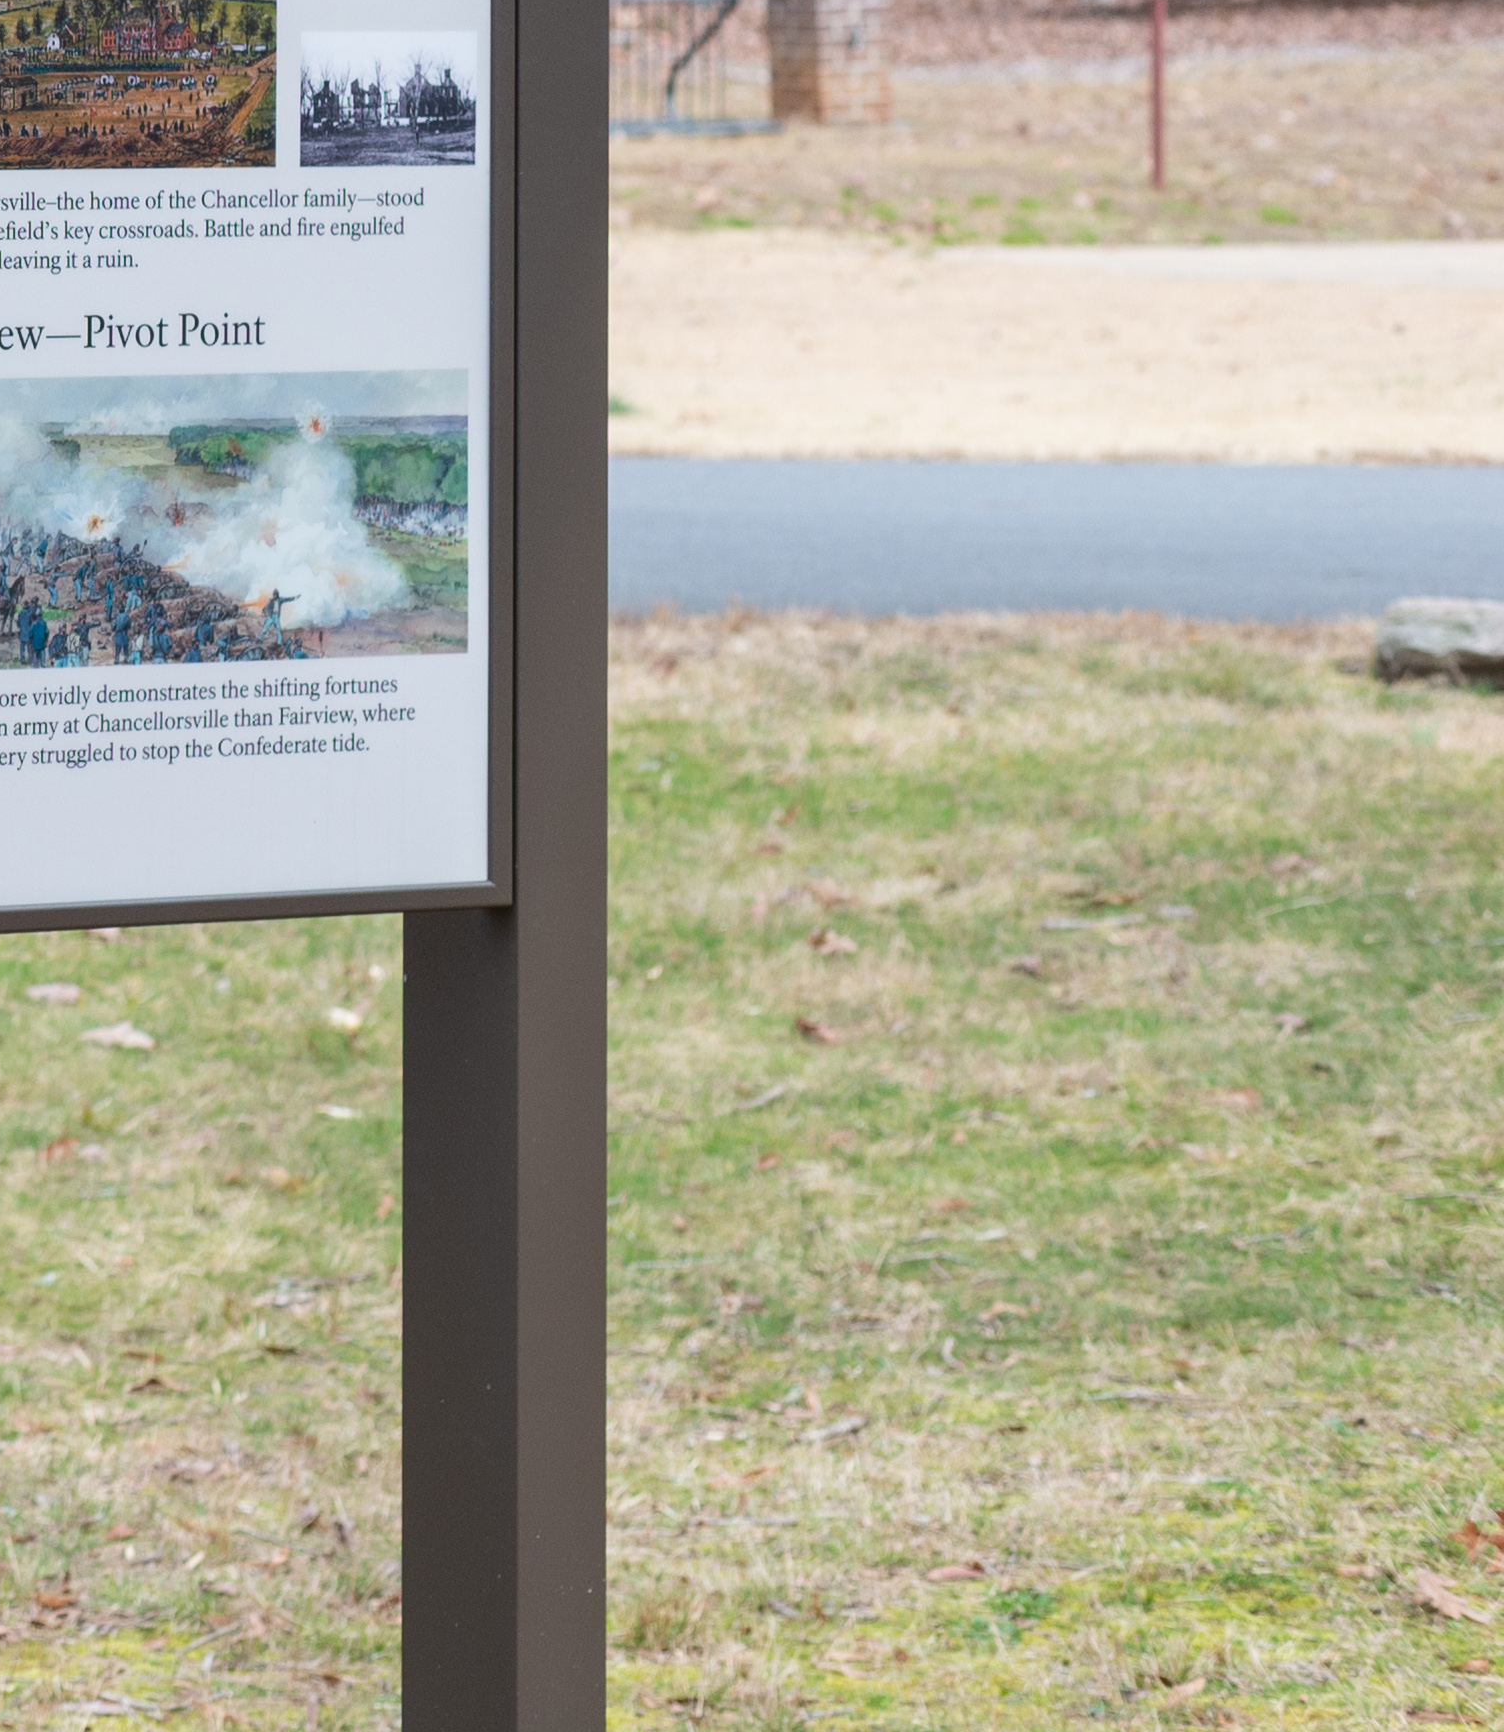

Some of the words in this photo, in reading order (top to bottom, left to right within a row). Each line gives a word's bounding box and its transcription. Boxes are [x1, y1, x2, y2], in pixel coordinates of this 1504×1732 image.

[89, 190, 140, 210] home
[144, 189, 164, 210] of
[168, 189, 198, 211] the
[201, 188, 299, 209] Chancellor
[178, 312, 266, 347] Point
[32, 685, 92, 711] vividly
[96, 684, 217, 704] demonstrates
[221, 679, 249, 700] the
[254, 676, 321, 702] shifting
[325, 675, 398, 695] fortunes
